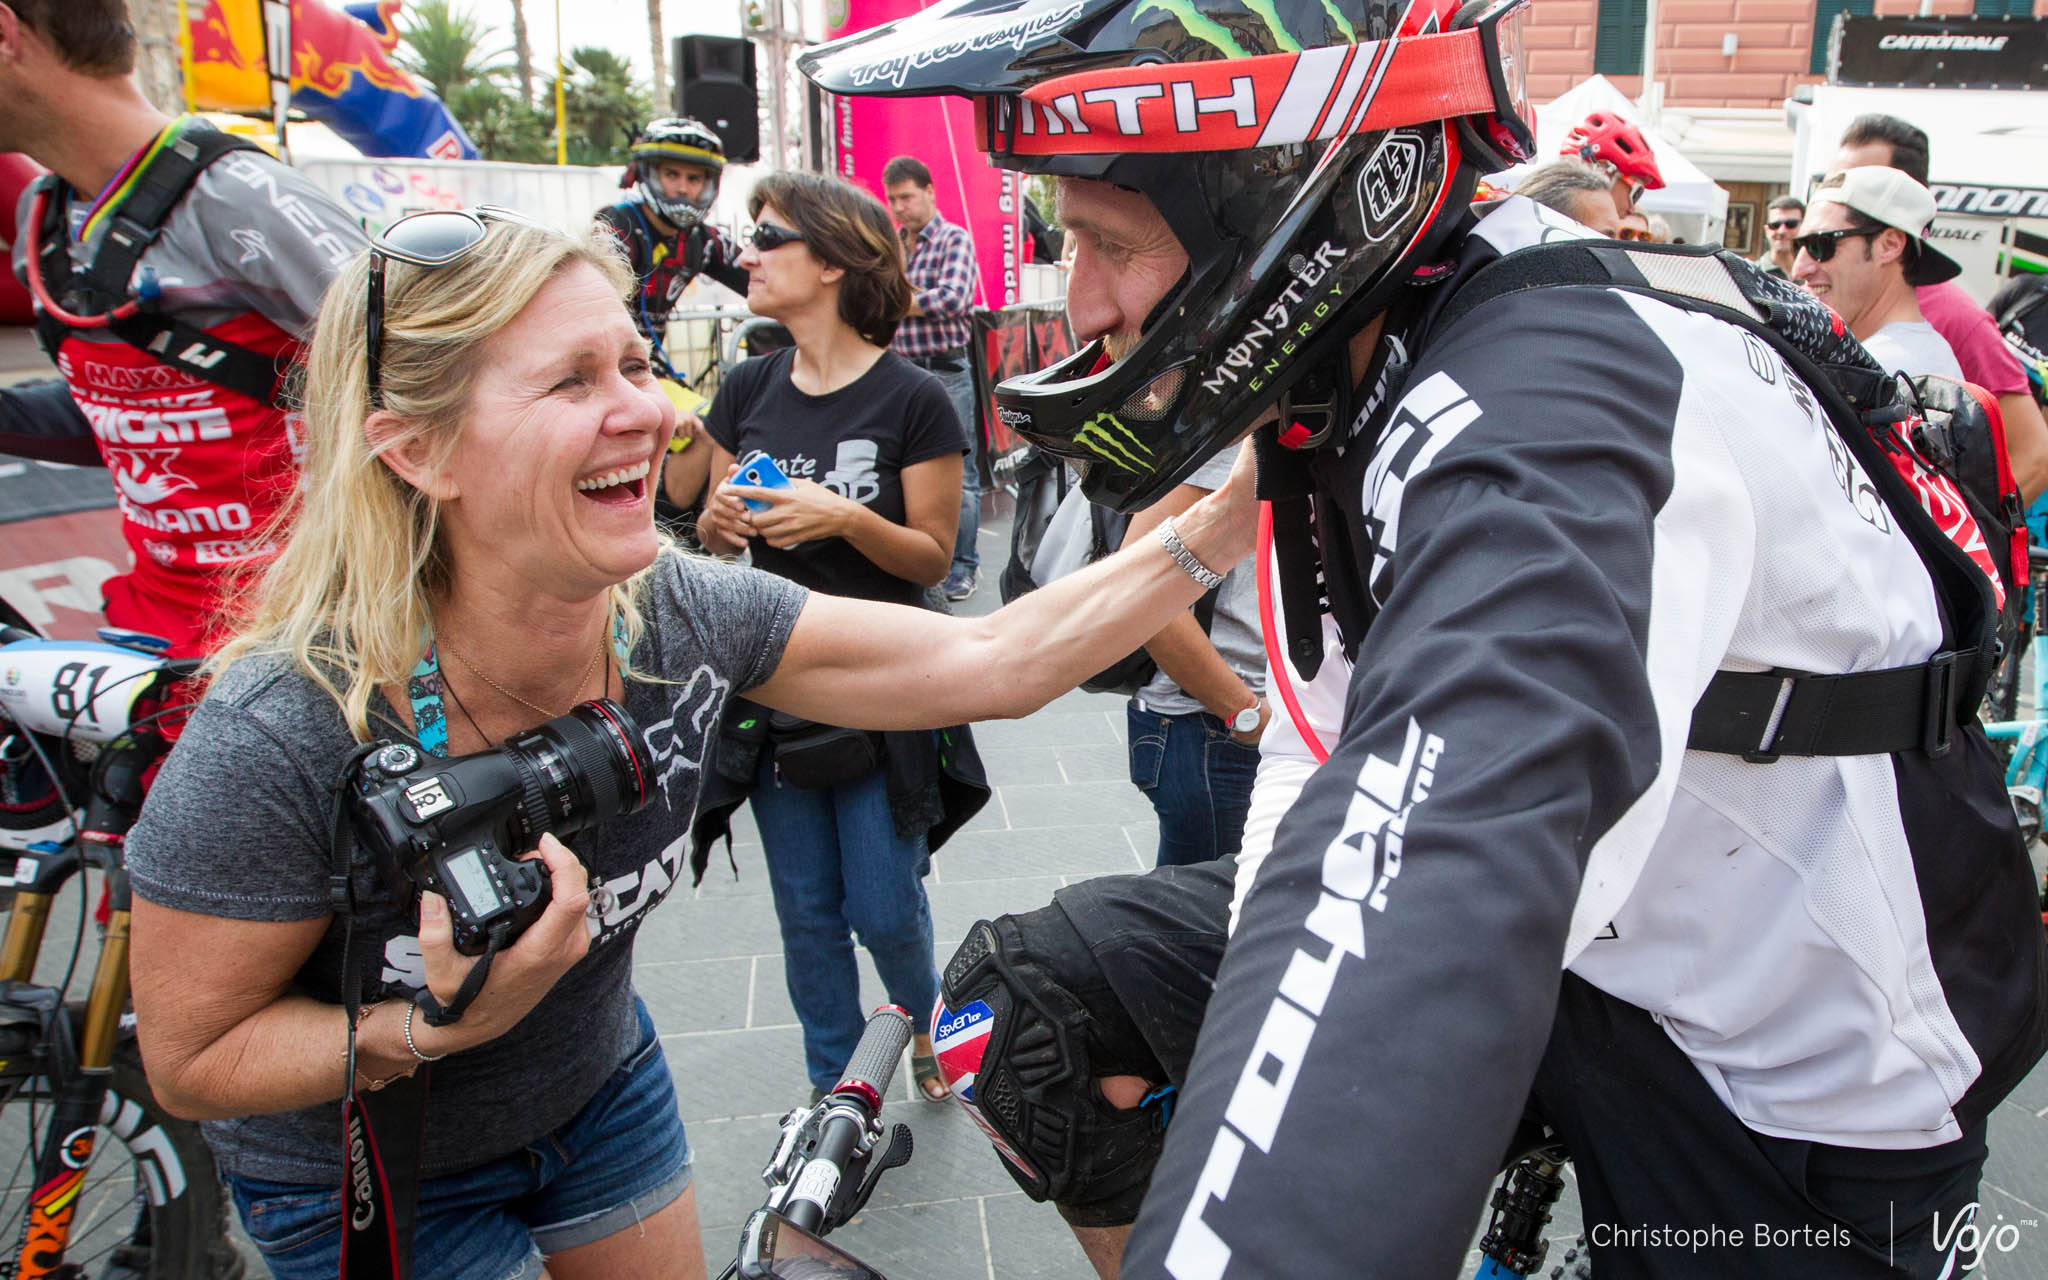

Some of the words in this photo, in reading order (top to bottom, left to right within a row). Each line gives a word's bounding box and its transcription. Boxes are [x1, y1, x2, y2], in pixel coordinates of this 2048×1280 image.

[850, 55, 908, 87] Troy
[911, 39, 966, 68] Lee
[998, 76, 1259, 136] MITH
[224, 158, 352, 272] ONEA
[1202, 240, 1347, 395] MONSTER
[1249, 282, 1343, 392] ENERGY
[52, 661, 112, 723] 81
[349, 1116, 375, 1232] Canon
